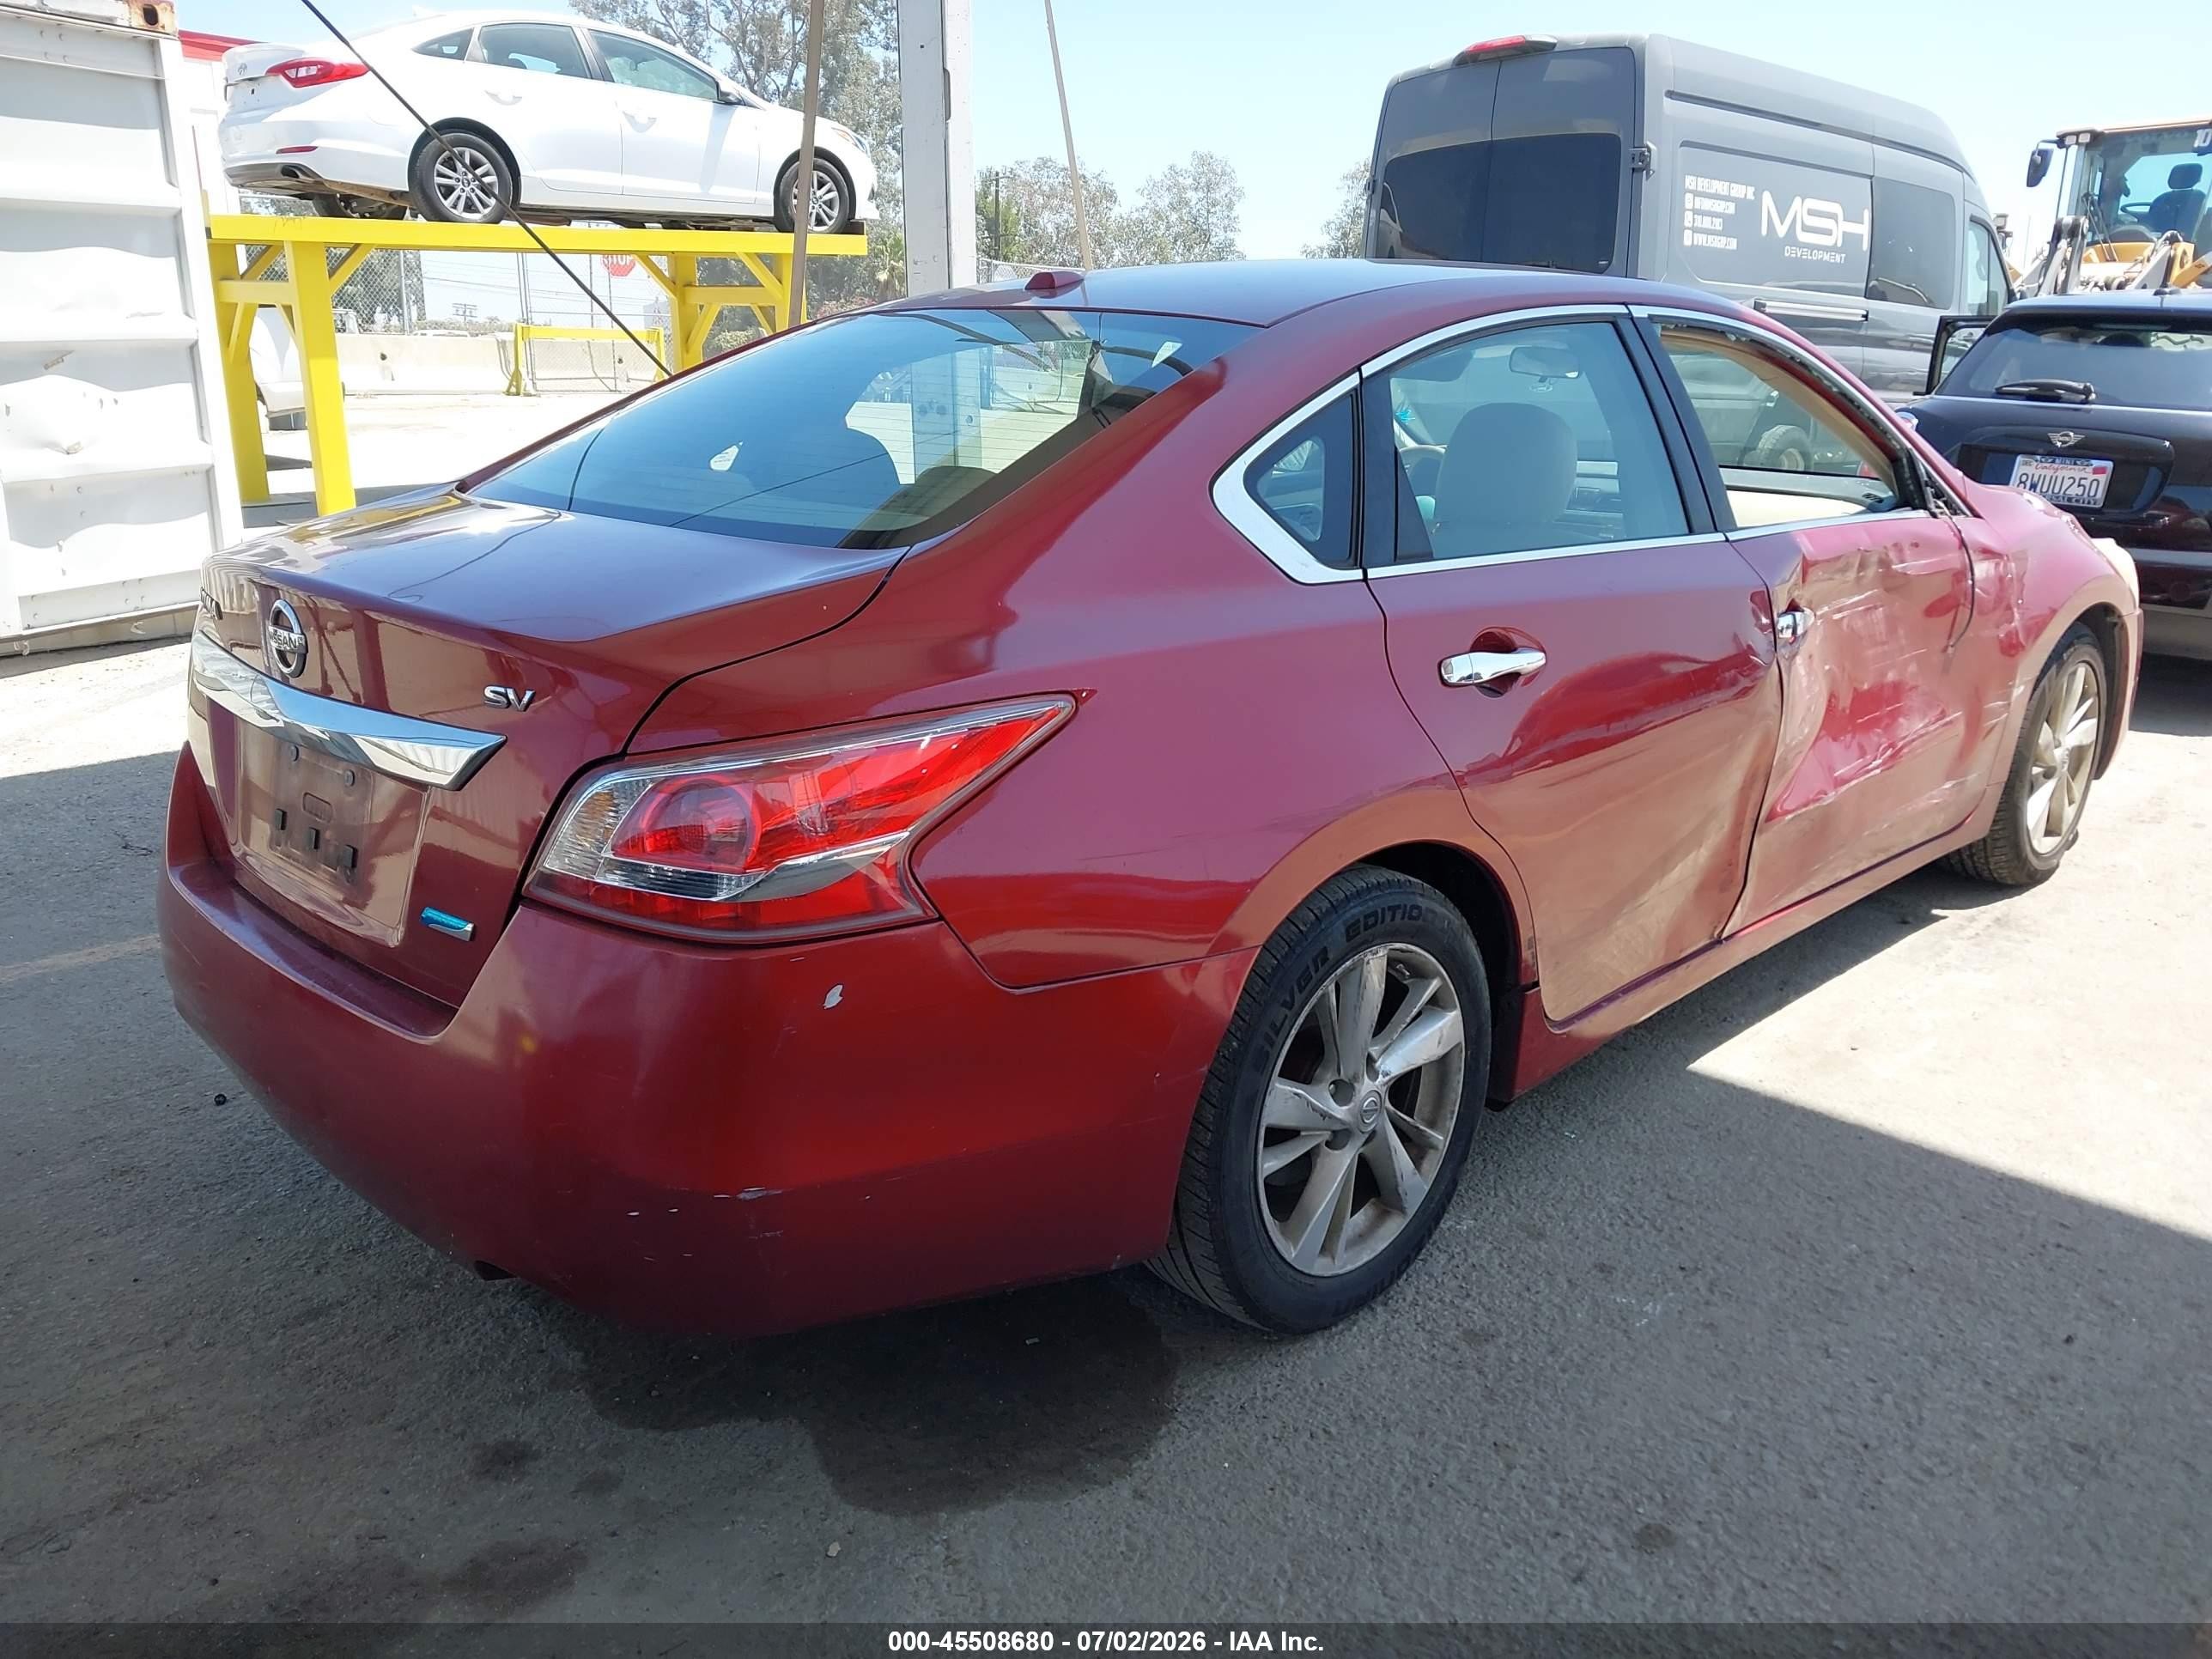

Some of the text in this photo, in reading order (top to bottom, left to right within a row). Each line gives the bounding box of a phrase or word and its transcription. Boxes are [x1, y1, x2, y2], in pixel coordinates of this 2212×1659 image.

[1760, 190, 1869, 251] MSH
[1784, 246, 1846, 264] DEVELOPMENT
[2034, 463, 2087, 475] California
[2016, 473, 2100, 498] 8WUU250
[268, 629, 297, 649] NISSAN
[483, 685, 535, 711] SV
